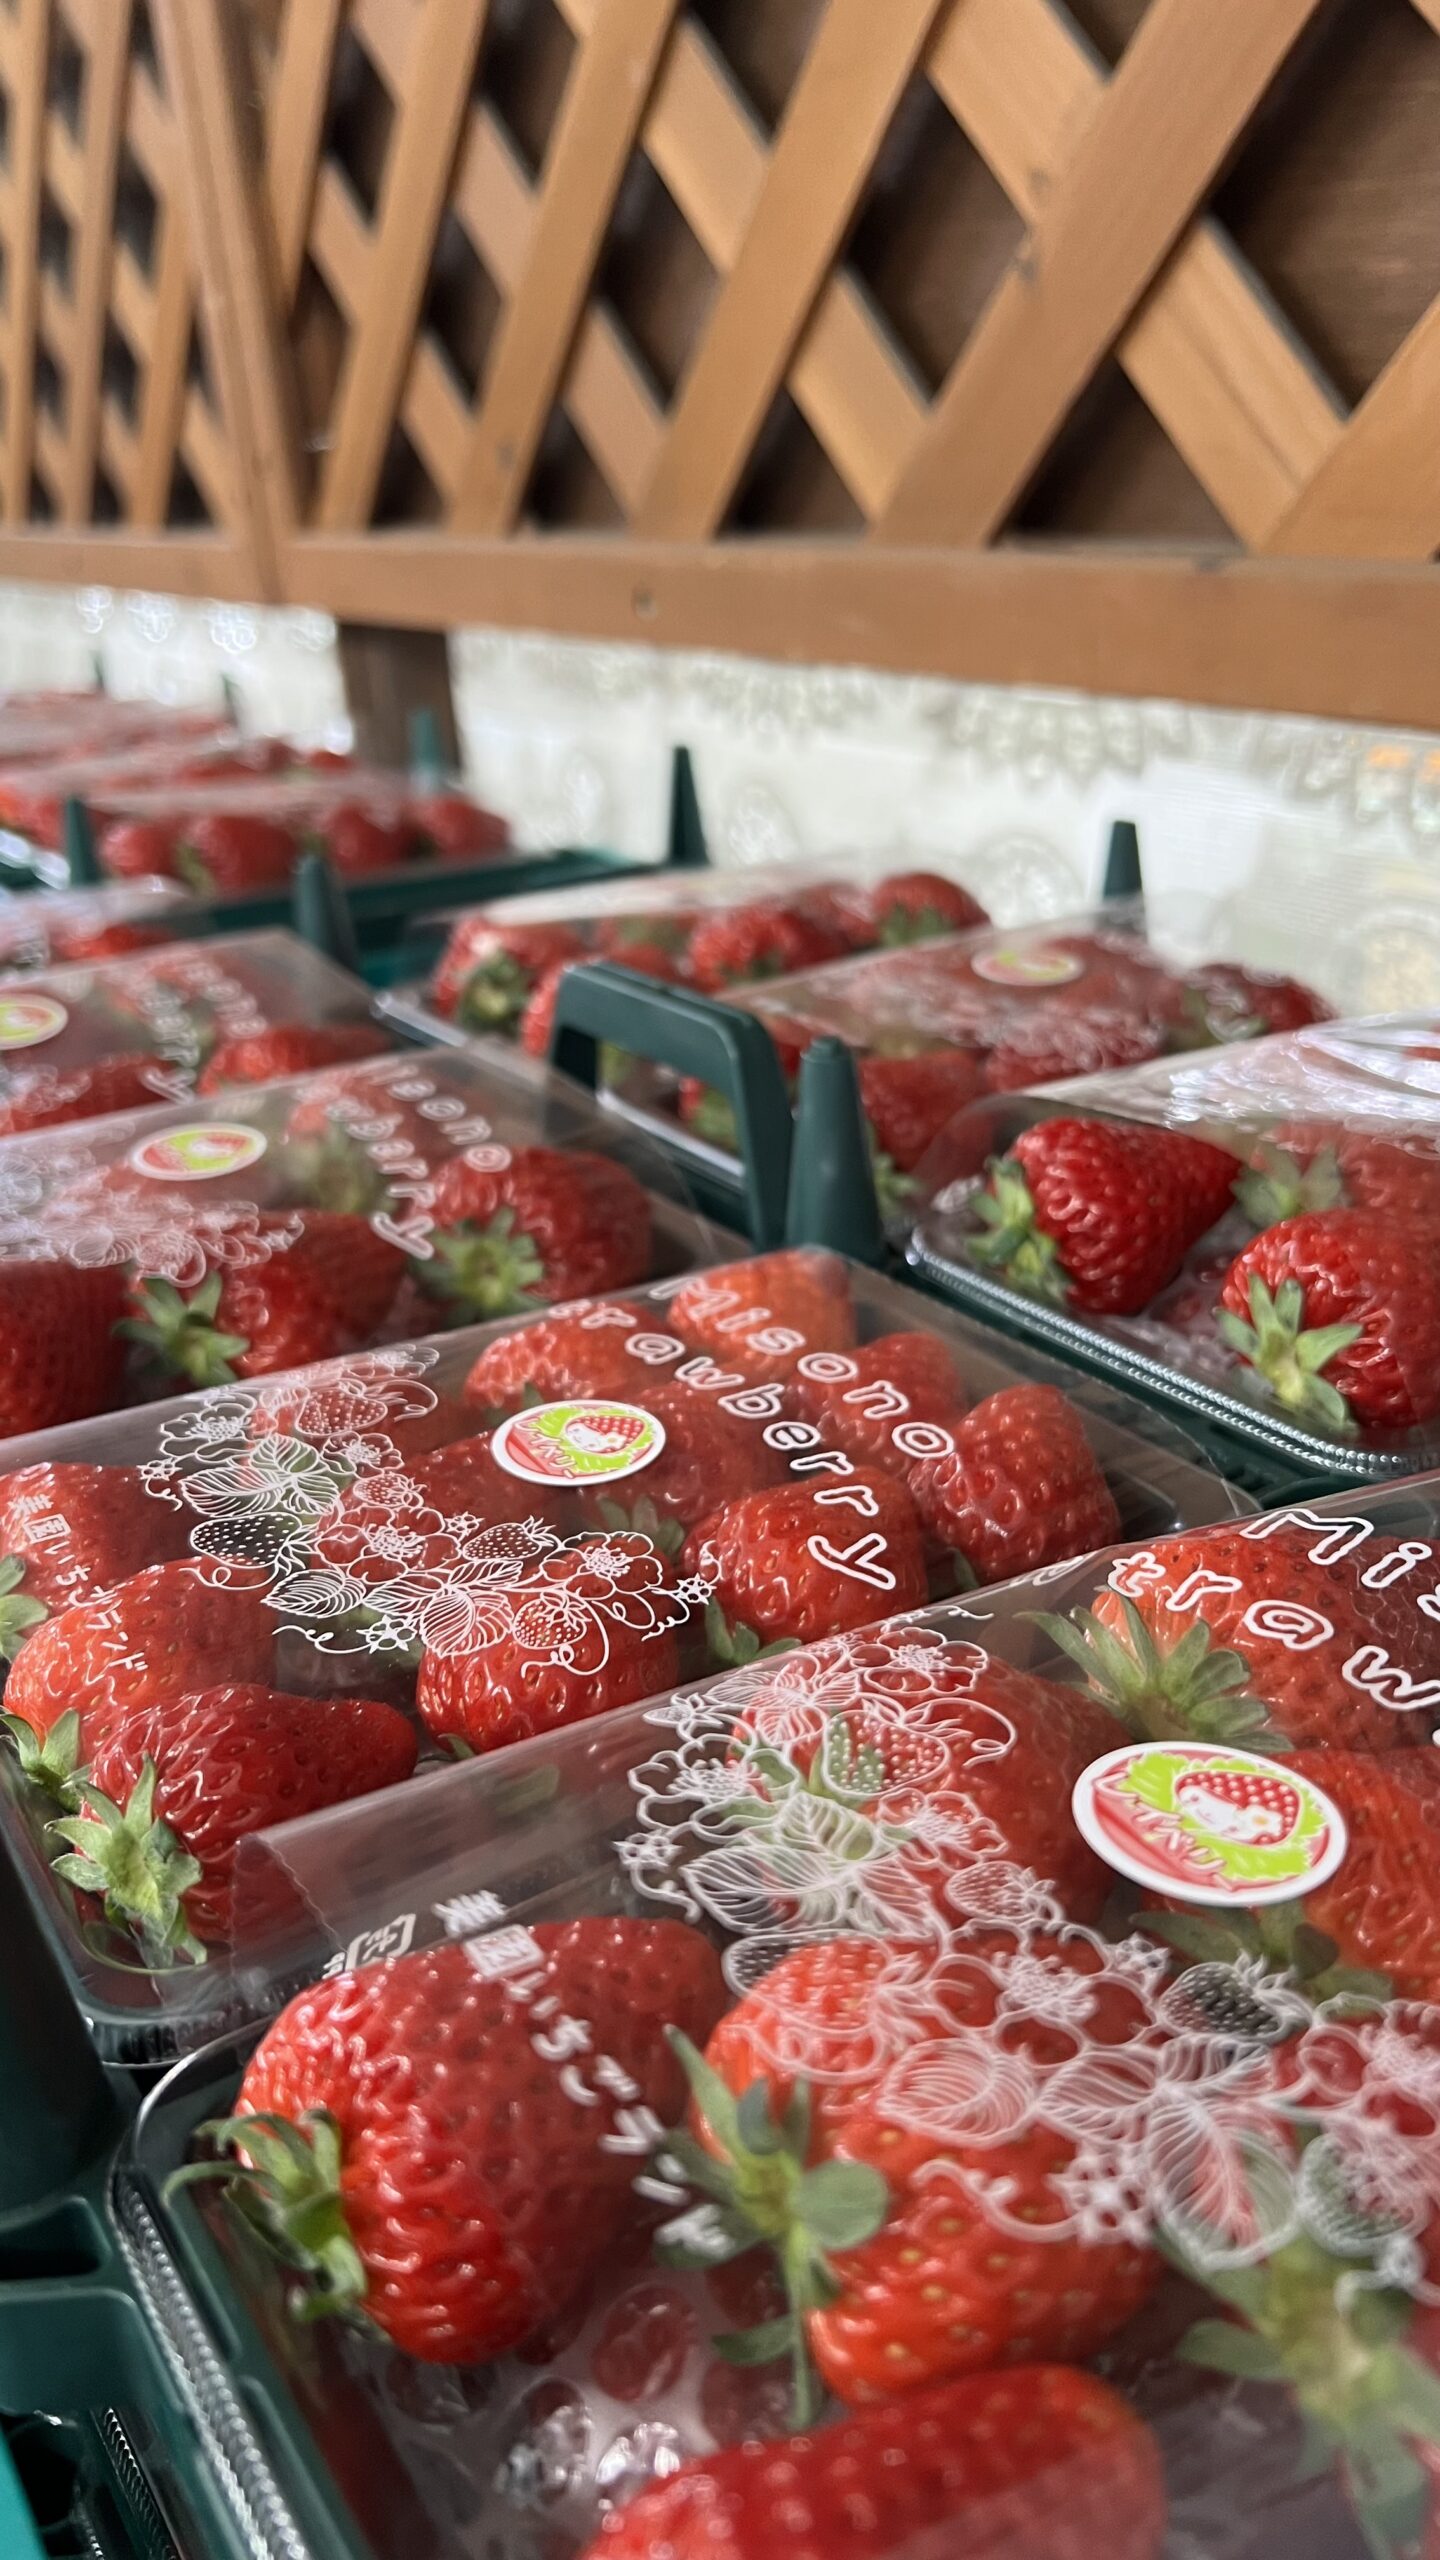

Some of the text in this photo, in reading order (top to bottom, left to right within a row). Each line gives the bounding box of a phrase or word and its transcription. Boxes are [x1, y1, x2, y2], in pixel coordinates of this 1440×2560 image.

[549, 1300, 896, 1590] trawberry
[649, 1277, 955, 1459] Misono
[1239, 1508, 1440, 1623] Mi
